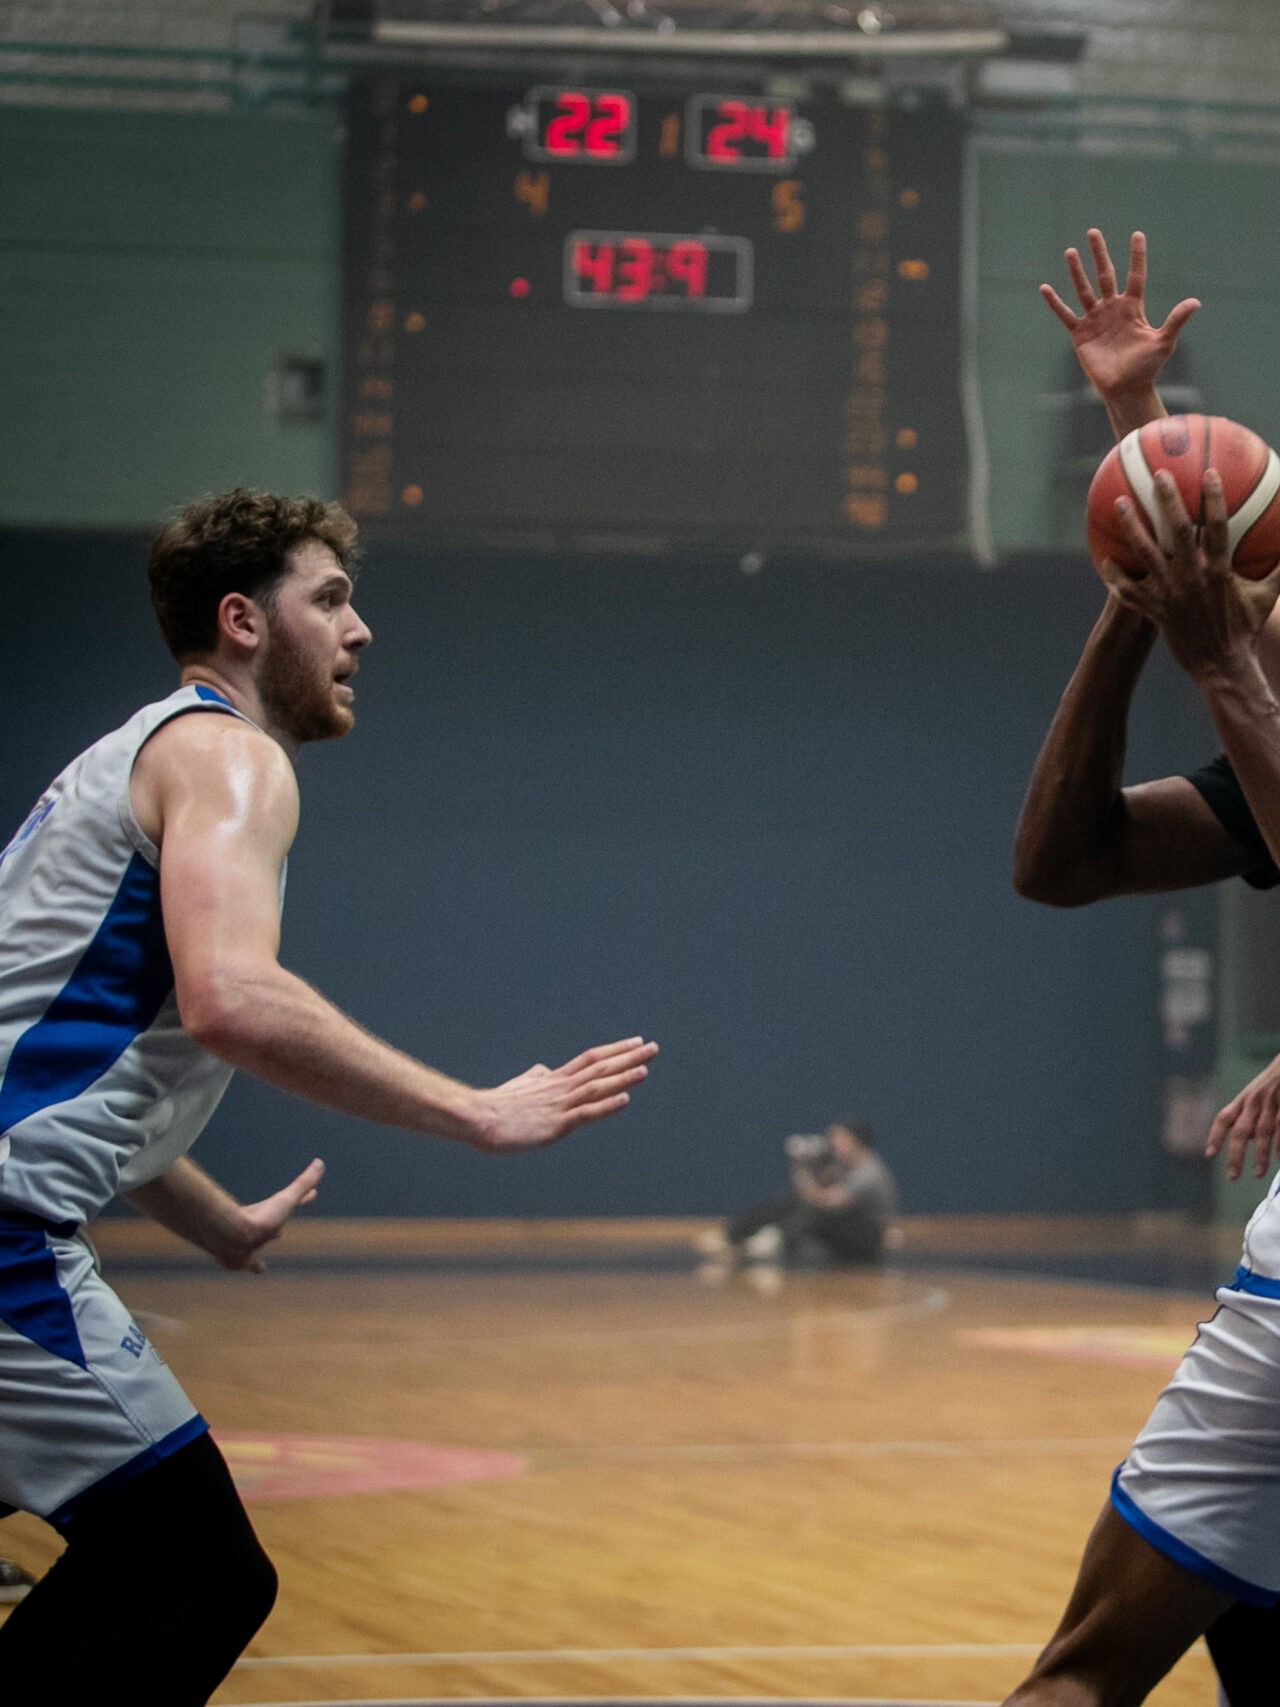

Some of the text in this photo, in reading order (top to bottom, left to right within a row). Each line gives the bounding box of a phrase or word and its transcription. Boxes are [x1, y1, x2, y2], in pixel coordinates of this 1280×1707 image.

[545, 93, 631, 158] 22
[707, 101, 792, 165] 24
[514, 171, 550, 216] 4
